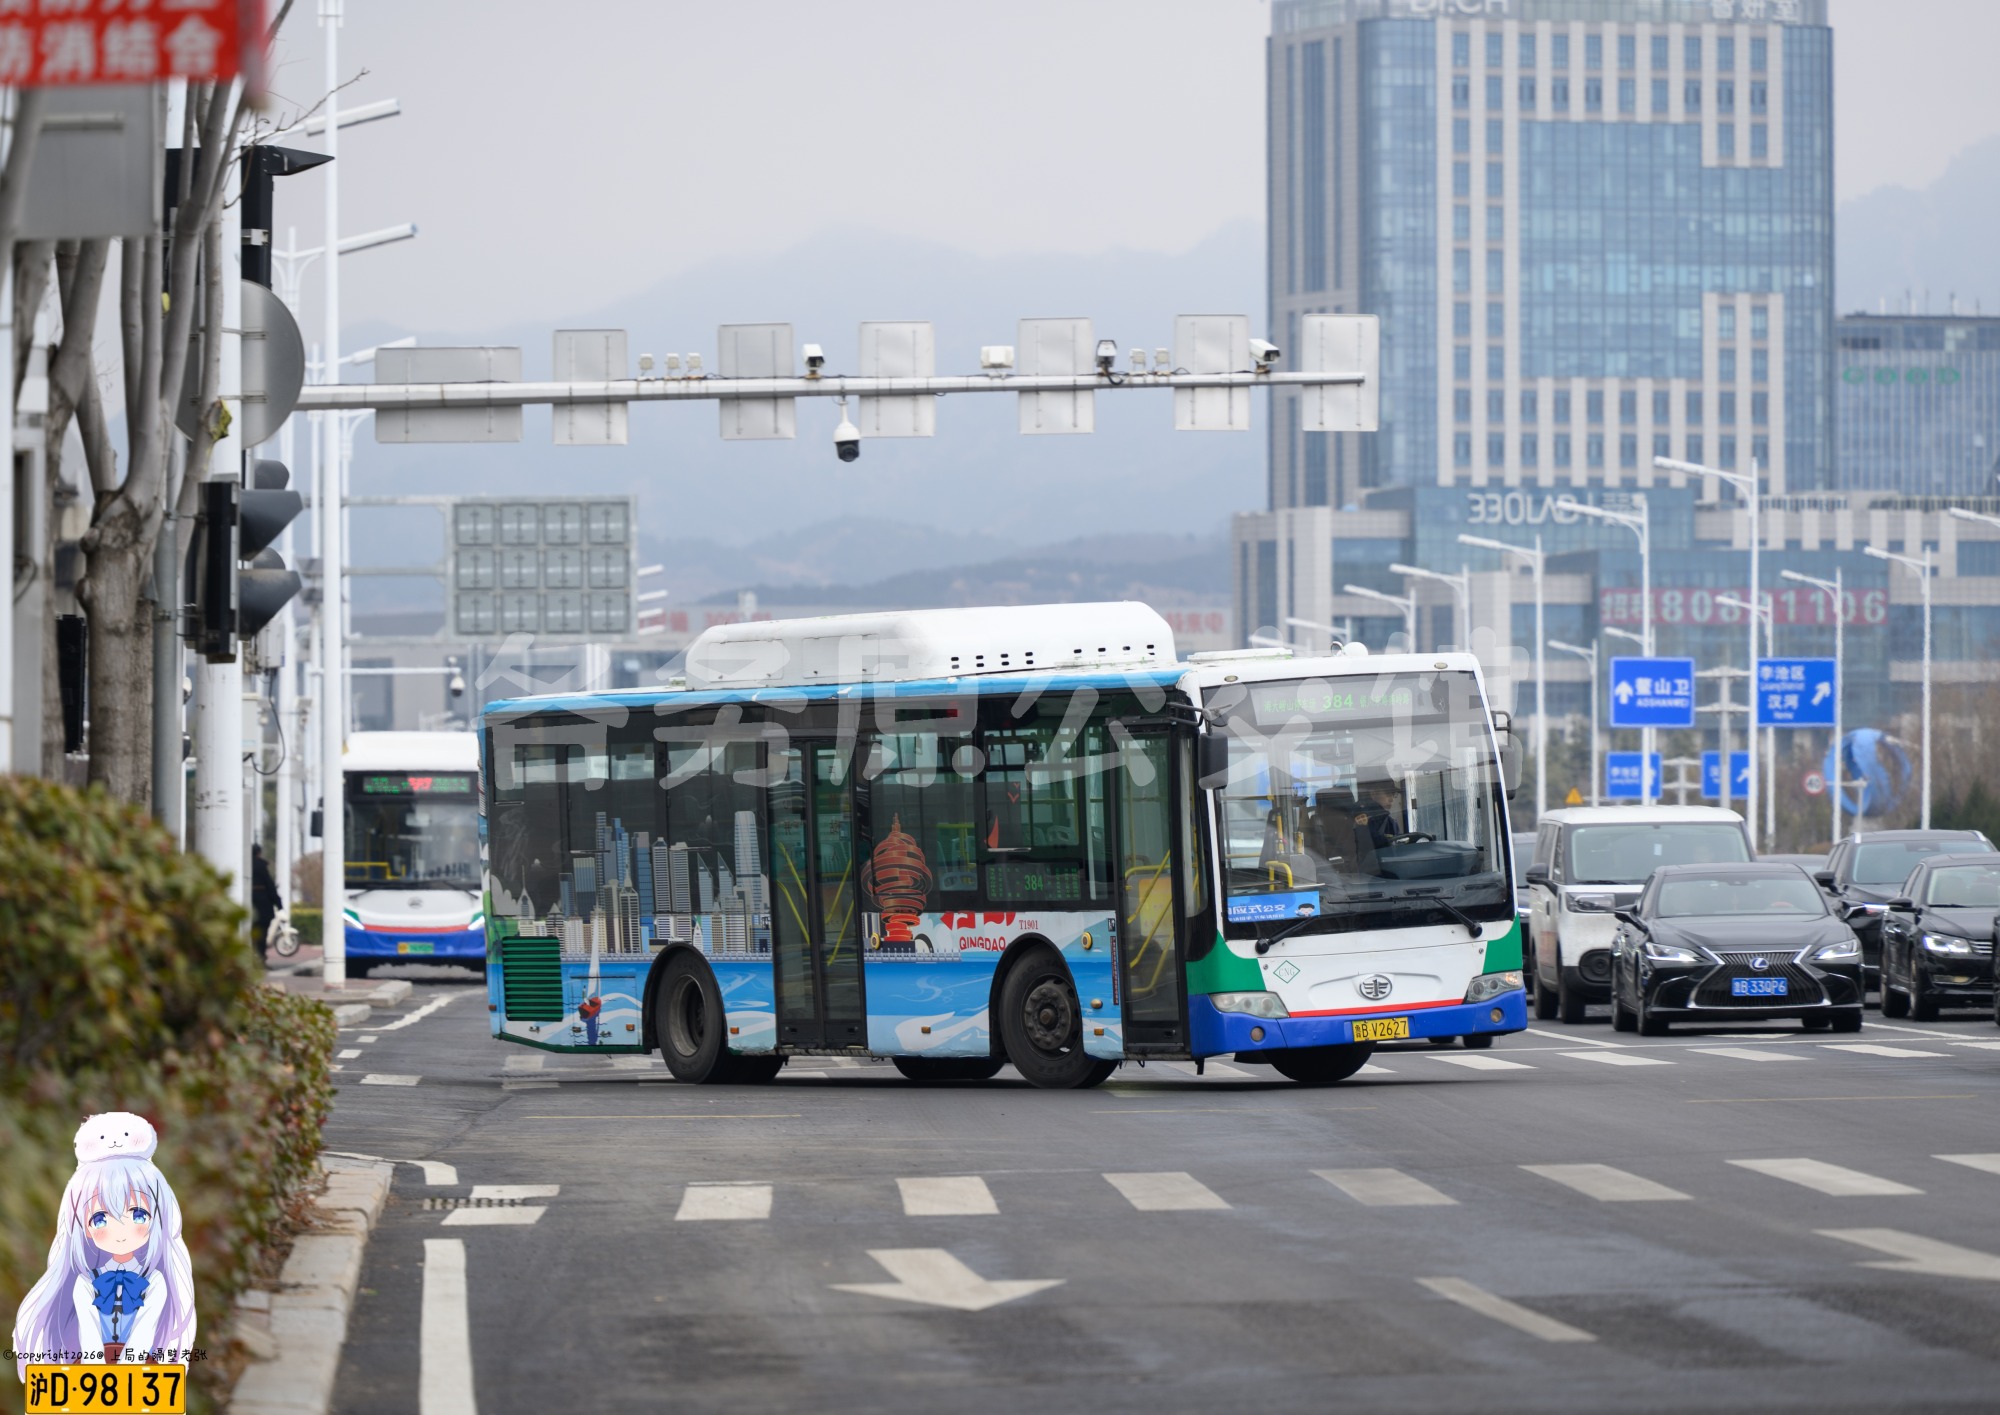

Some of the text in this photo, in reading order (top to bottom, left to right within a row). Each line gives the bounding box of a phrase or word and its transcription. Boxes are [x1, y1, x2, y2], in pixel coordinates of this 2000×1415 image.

[1322, 693, 1354, 710] 384
[1024, 874, 1044, 891] 384
[1019, 919, 1039, 930] T1901
[959, 936, 1006, 952] QINGDAO
[1278, 967, 1296, 976] CNG
